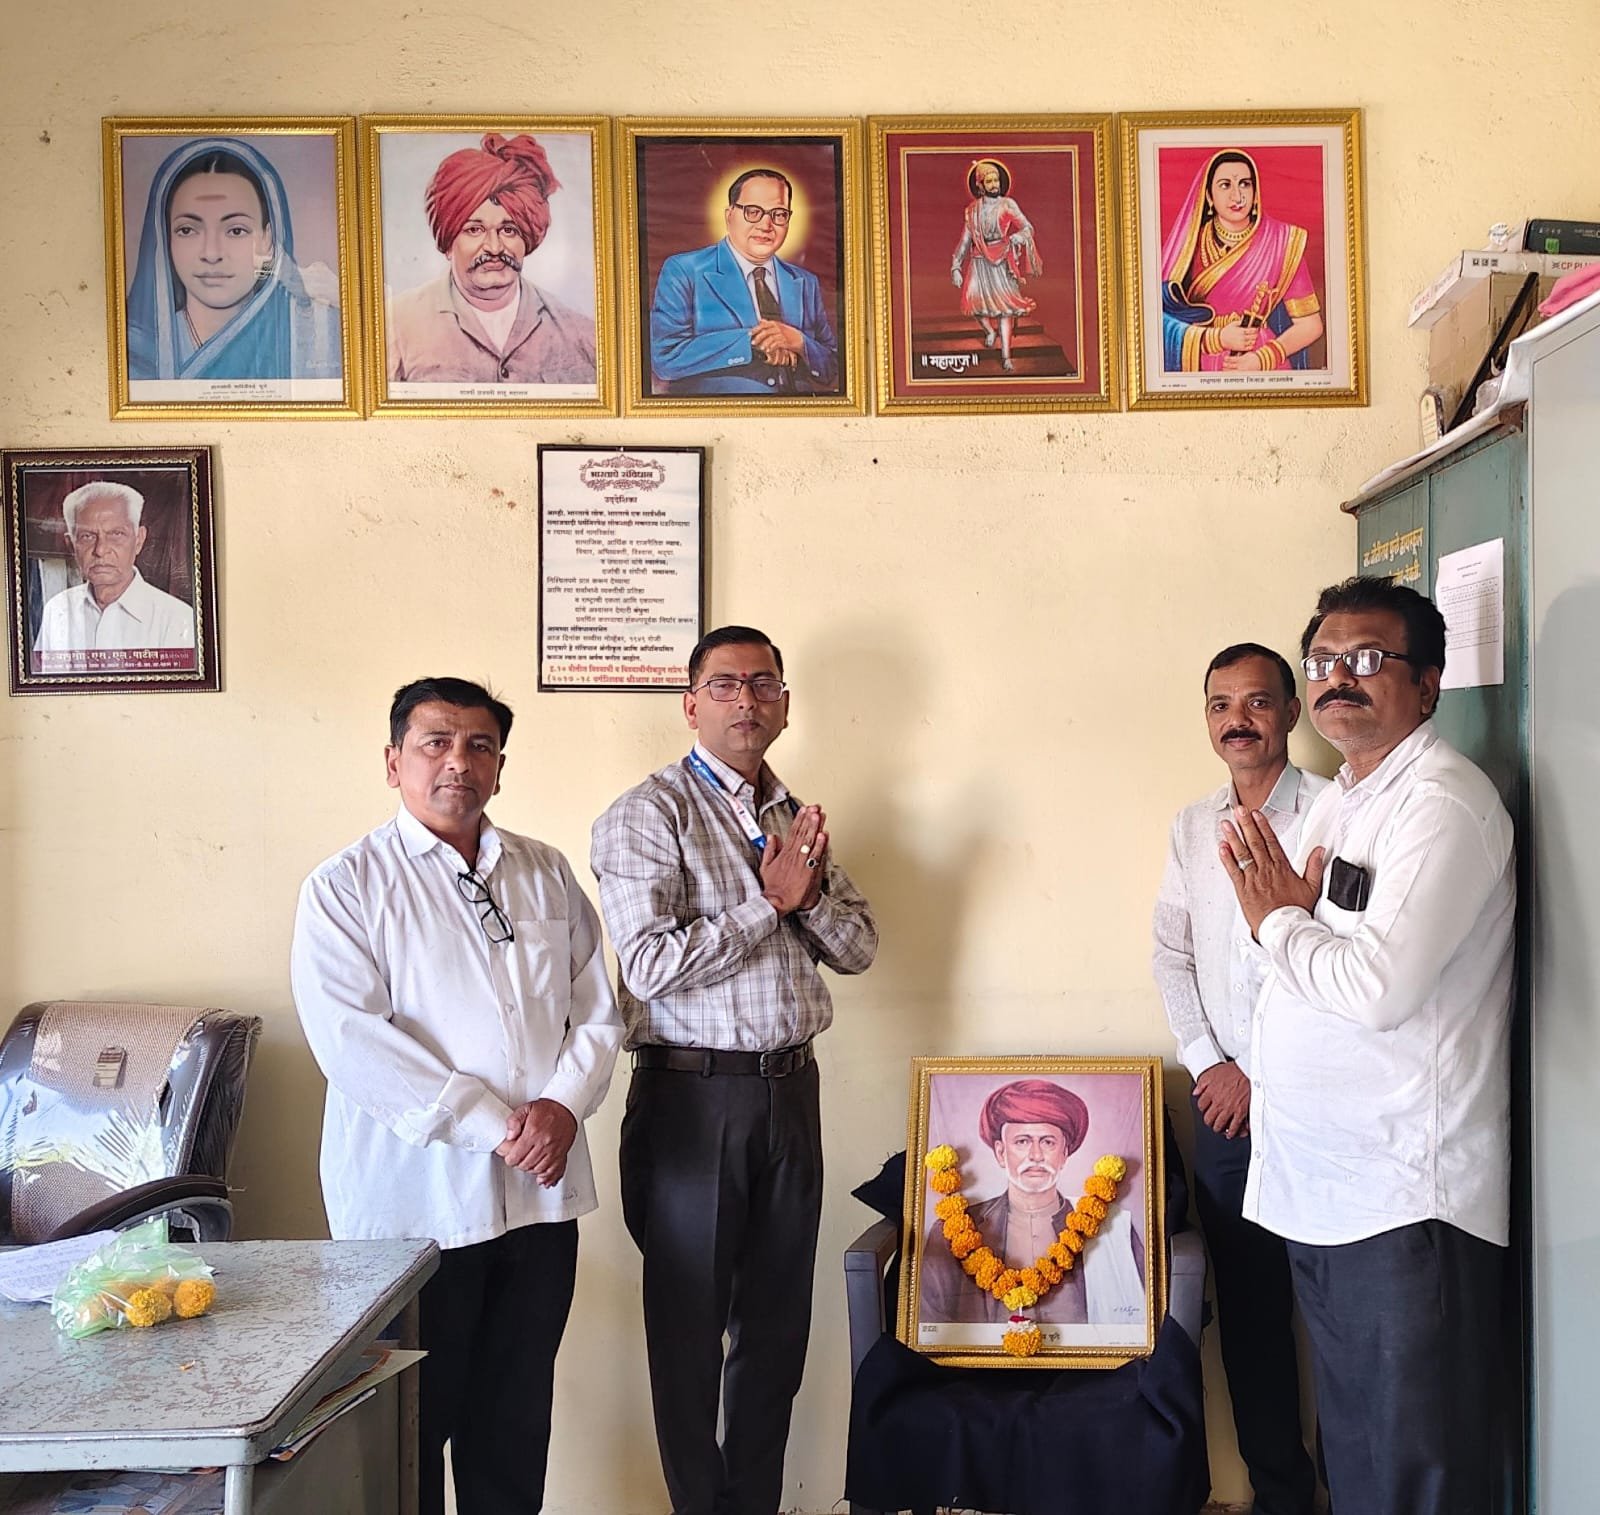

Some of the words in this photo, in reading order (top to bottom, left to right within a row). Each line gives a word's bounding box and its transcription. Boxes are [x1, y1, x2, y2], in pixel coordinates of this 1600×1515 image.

[929, 354, 971, 373] महाराज
[621, 470, 653, 478] संविधान
[132, 649, 159, 661] पाटील
